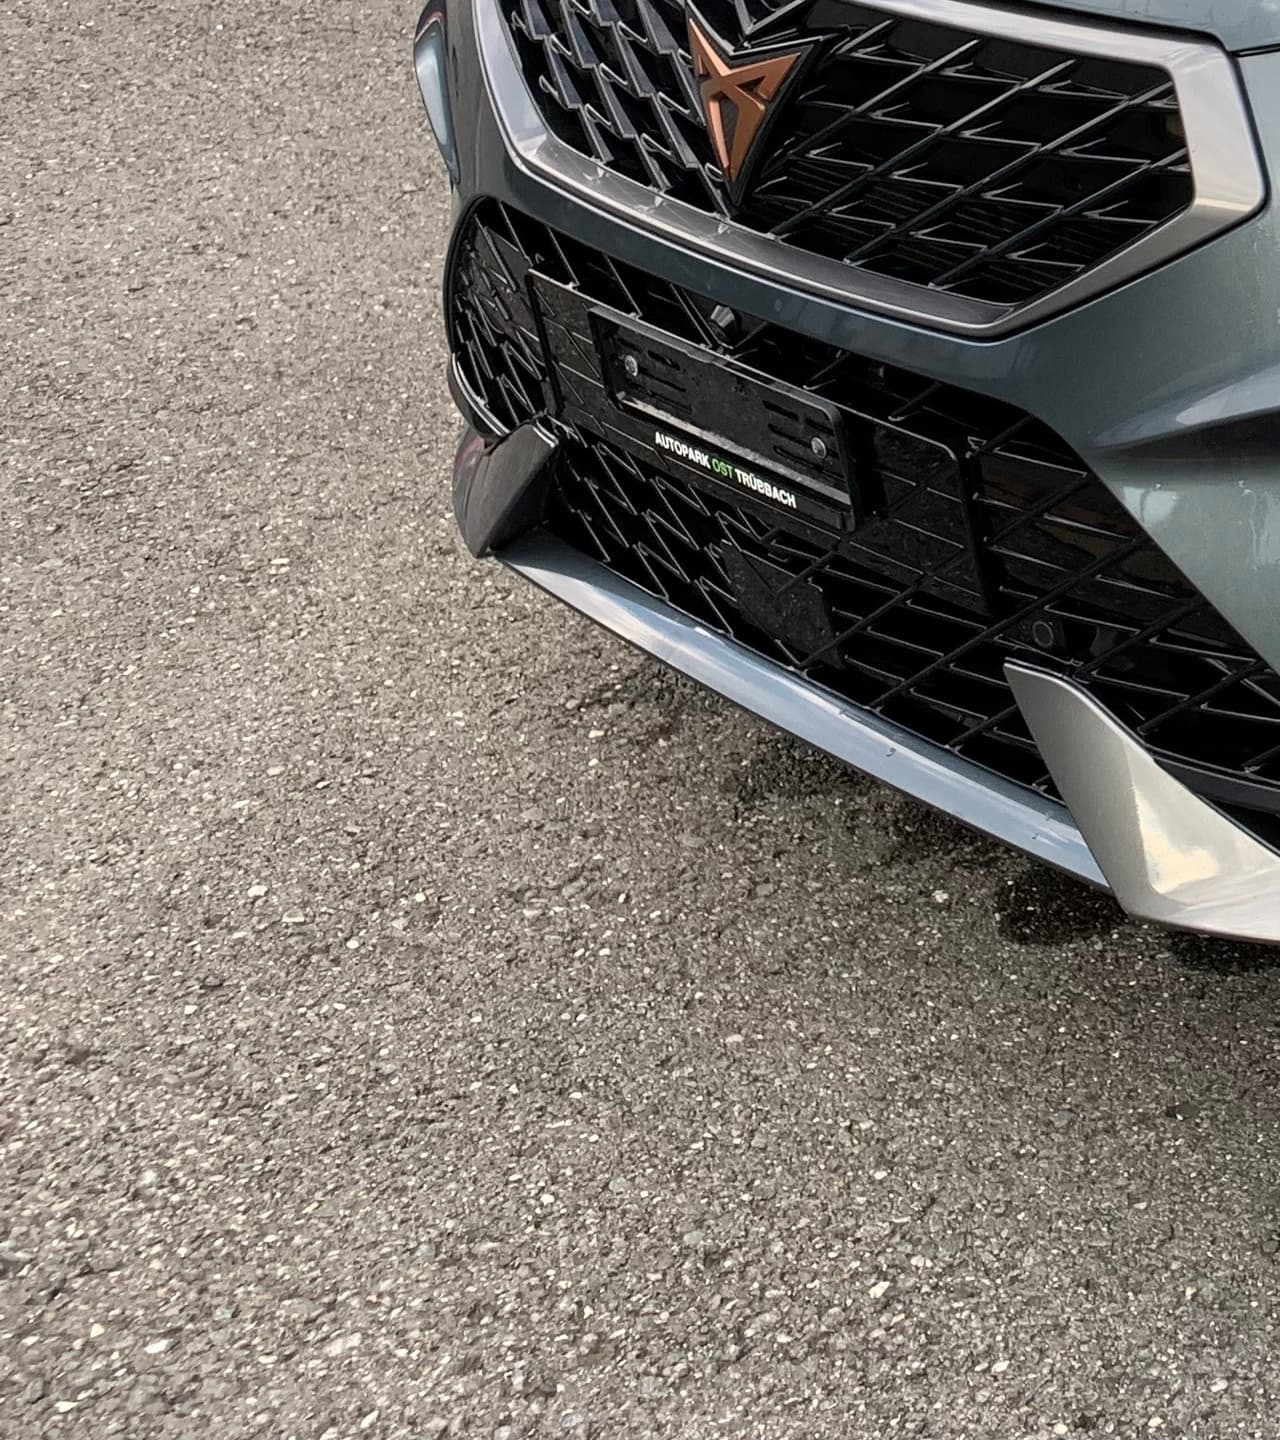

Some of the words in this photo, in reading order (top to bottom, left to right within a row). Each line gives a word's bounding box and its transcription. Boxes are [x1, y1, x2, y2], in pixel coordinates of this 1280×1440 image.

[655, 431, 711, 470] AUTOPARK
[711, 458, 734, 479] OST
[734, 468, 798, 509] TRÜBBACH
